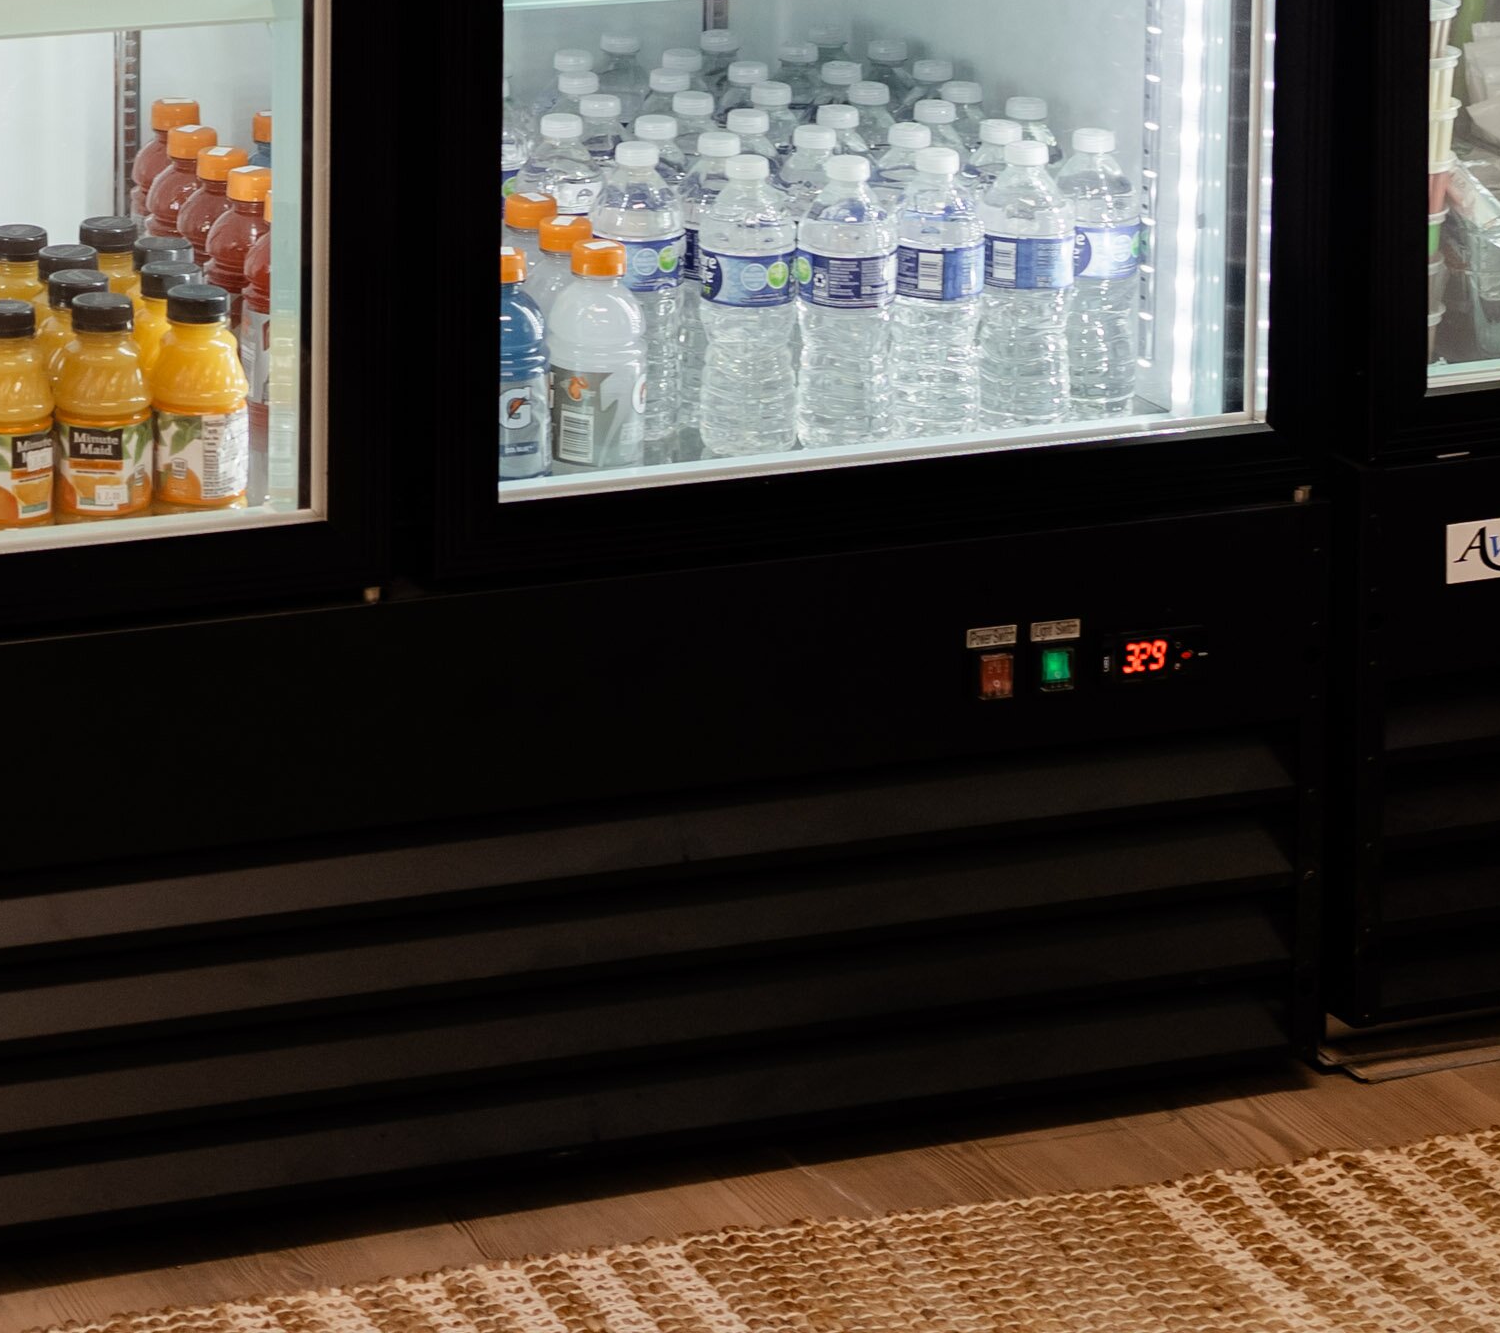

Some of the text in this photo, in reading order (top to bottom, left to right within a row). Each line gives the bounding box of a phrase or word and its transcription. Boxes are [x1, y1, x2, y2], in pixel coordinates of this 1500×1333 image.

[499, 388, 532, 429] G
[17, 438, 52, 453] Minute
[73, 432, 119, 445] Minute
[80, 443, 113, 456] Maid
